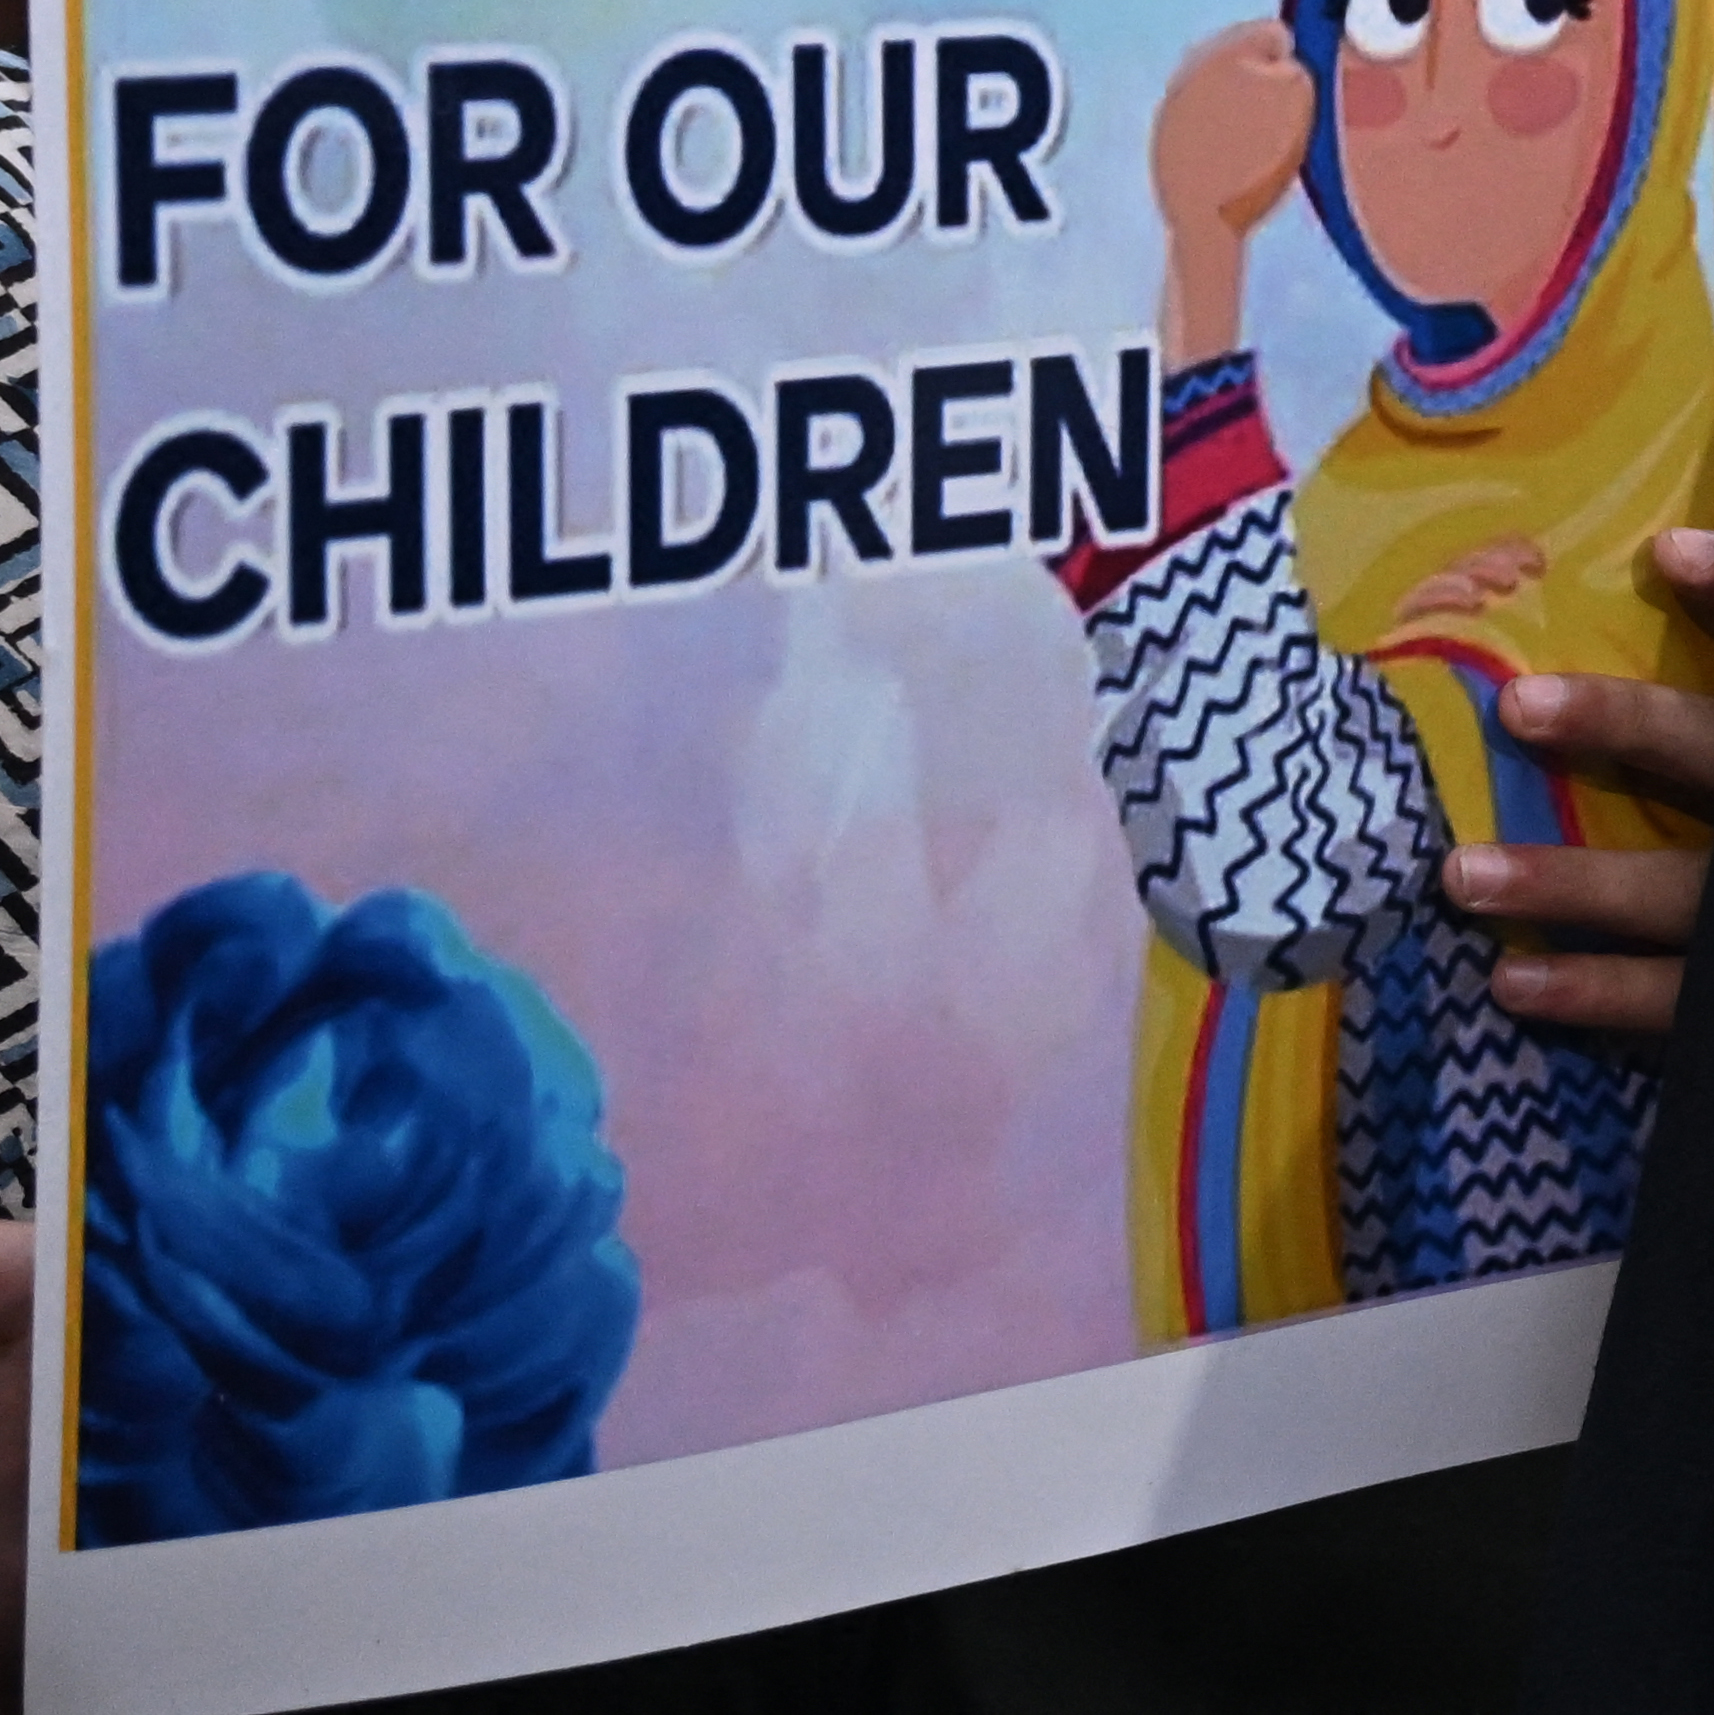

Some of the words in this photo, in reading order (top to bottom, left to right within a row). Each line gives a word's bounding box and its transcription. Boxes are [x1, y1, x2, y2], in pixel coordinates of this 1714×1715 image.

[113, 58, 560, 288] FOR
[623, 34, 1053, 248] OUR
[113, 346, 1161, 641] CHILDREN
